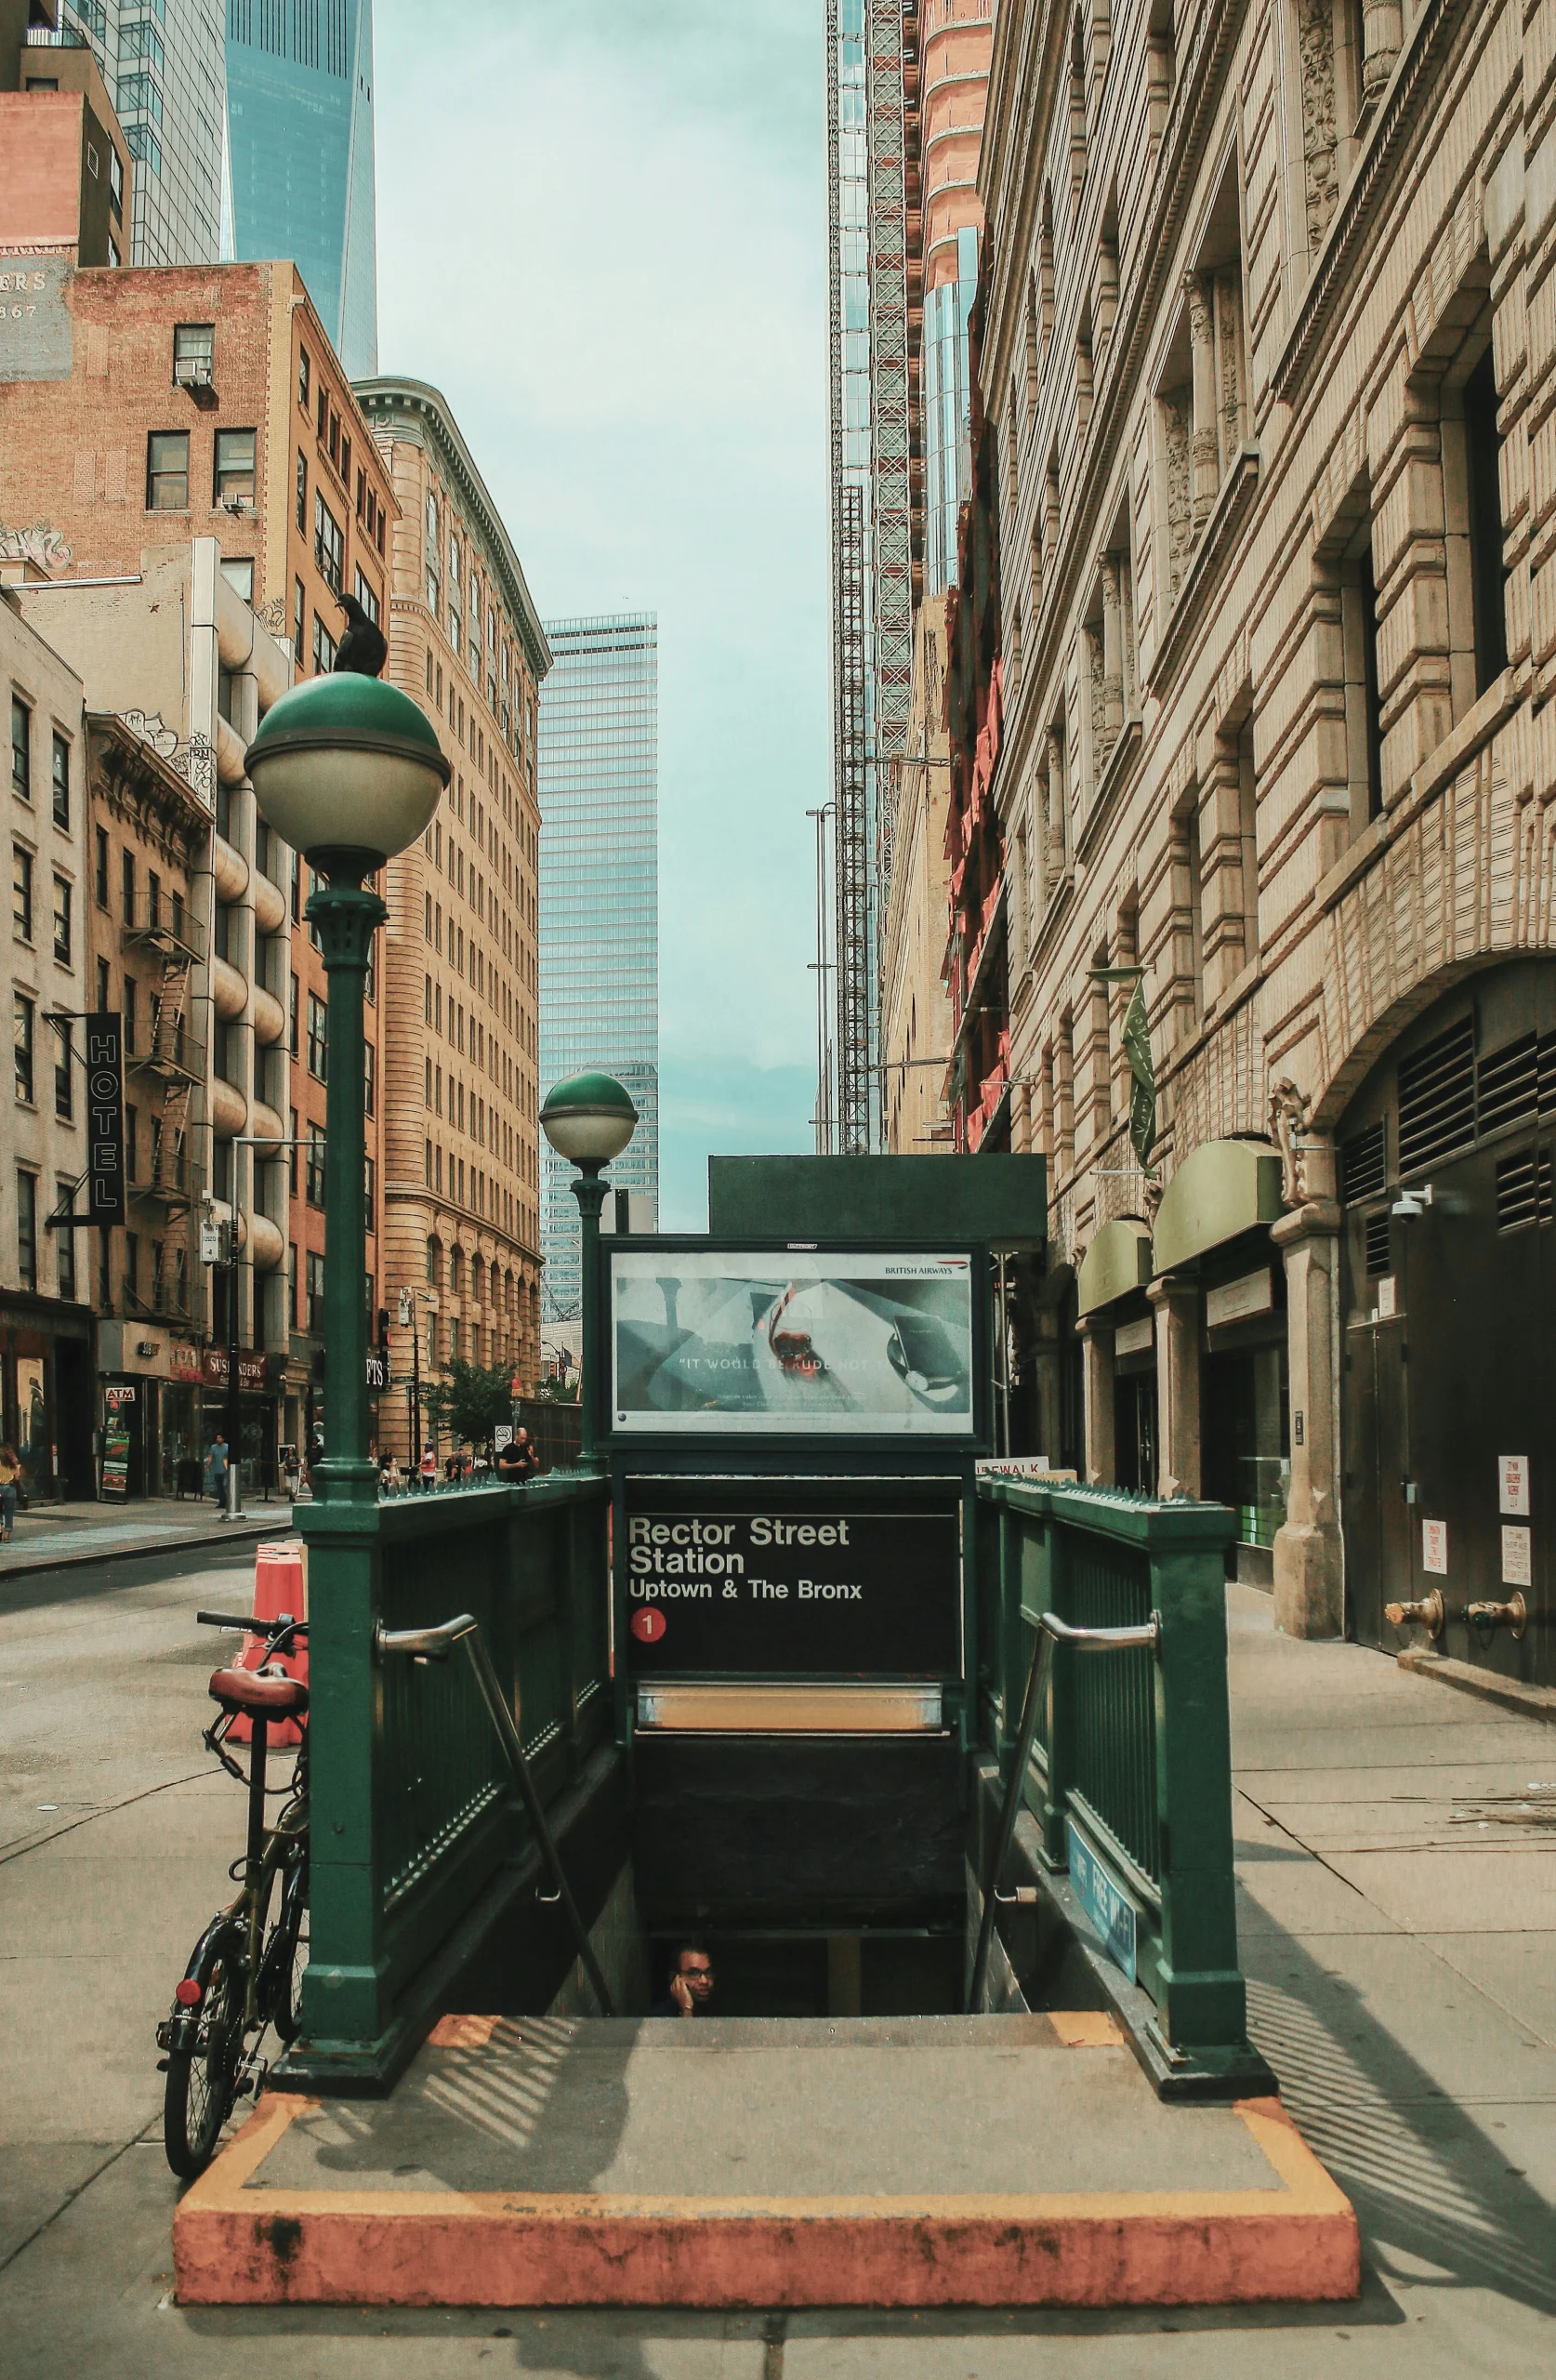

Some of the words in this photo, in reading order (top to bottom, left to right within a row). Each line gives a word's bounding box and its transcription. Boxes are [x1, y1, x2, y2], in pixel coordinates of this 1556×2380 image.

[90, 1035, 119, 1208] HOTEL
[706, 1357, 761, 1370] WOULD
[838, 1359, 867, 1371] NOT
[107, 1389, 133, 1397] ATM
[628, 1517, 736, 1545] Rector
[749, 1517, 850, 1545] Street
[629, 1545, 745, 1574] Station
[629, 1579, 713, 1601] Uptown
[721, 1579, 739, 1598] &
[747, 1580, 789, 1599] The
[798, 1580, 863, 1599] Bronx
[641, 1614, 653, 1634] 1
